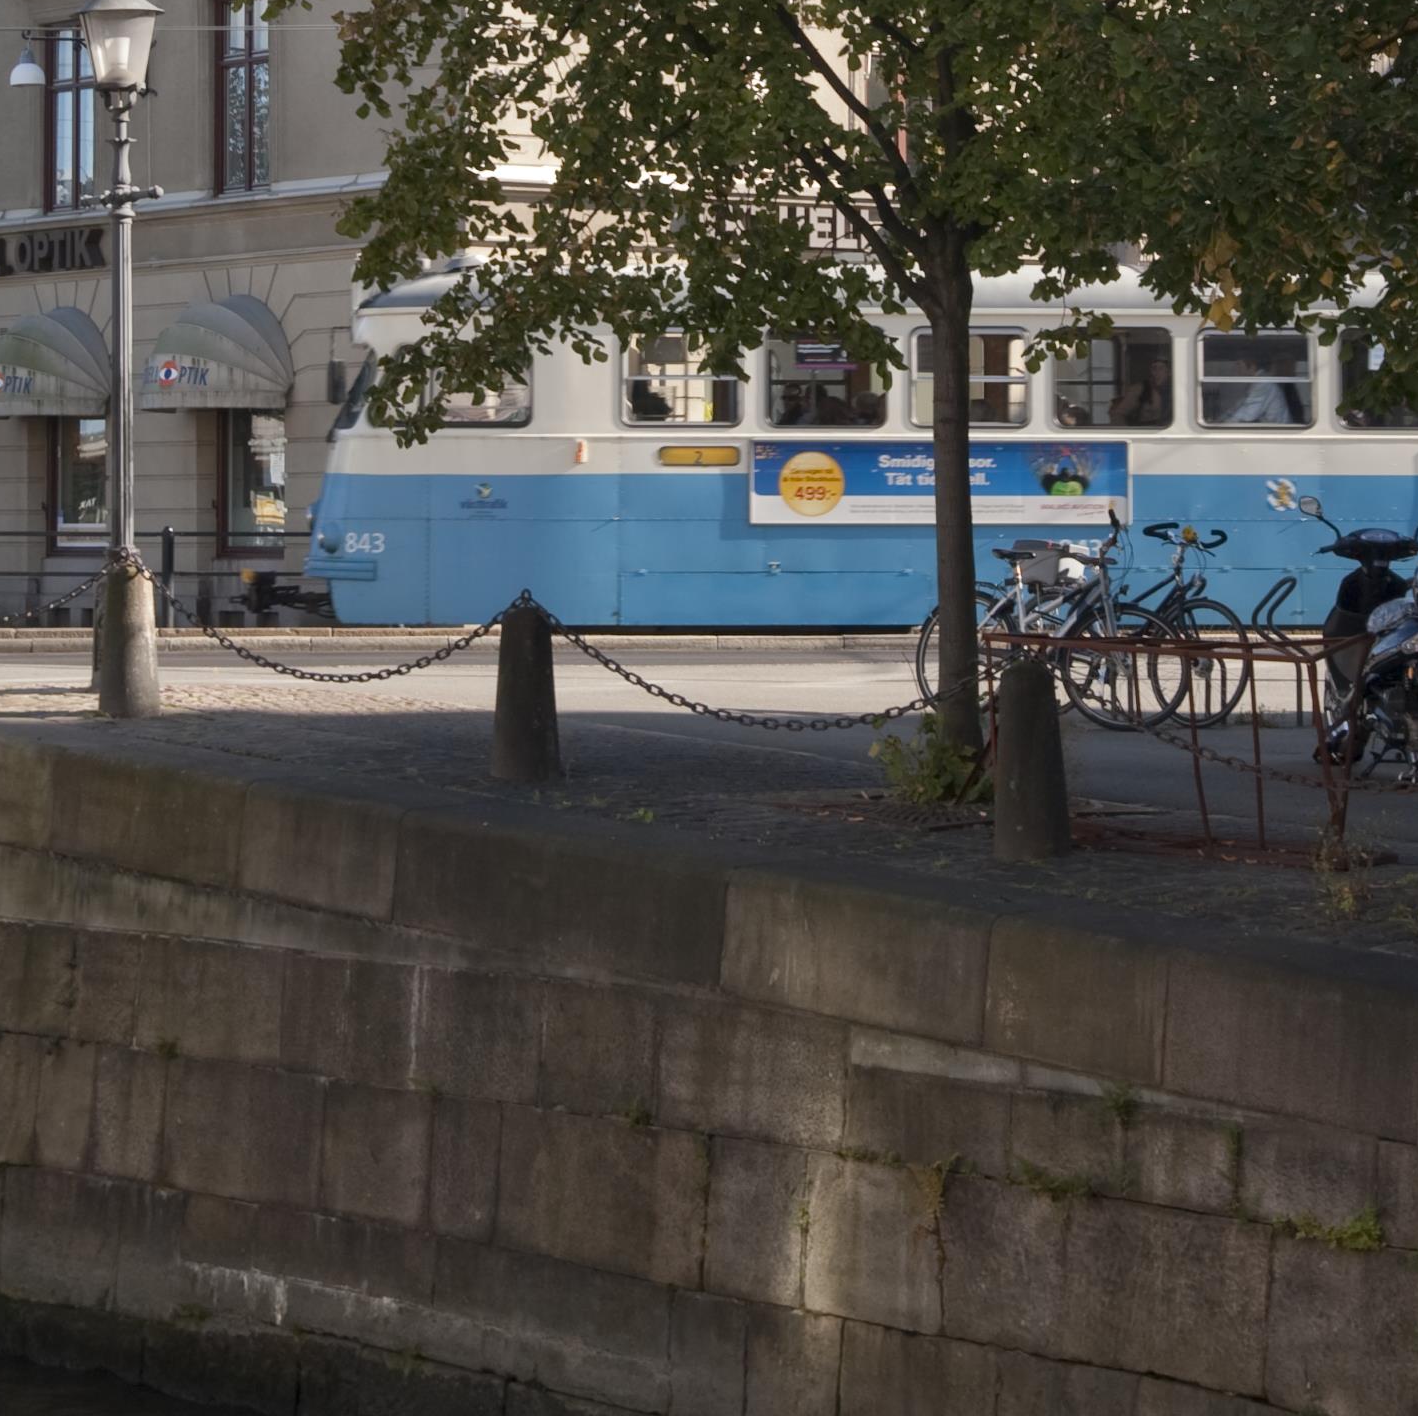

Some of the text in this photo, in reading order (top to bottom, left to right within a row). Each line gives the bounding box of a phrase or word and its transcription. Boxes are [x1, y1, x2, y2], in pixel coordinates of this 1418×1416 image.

[12, 229, 94, 272] OPTIK
[878, 455, 935, 471] Smidig
[885, 472, 913, 486] Tät
[345, 532, 385, 553] 843
